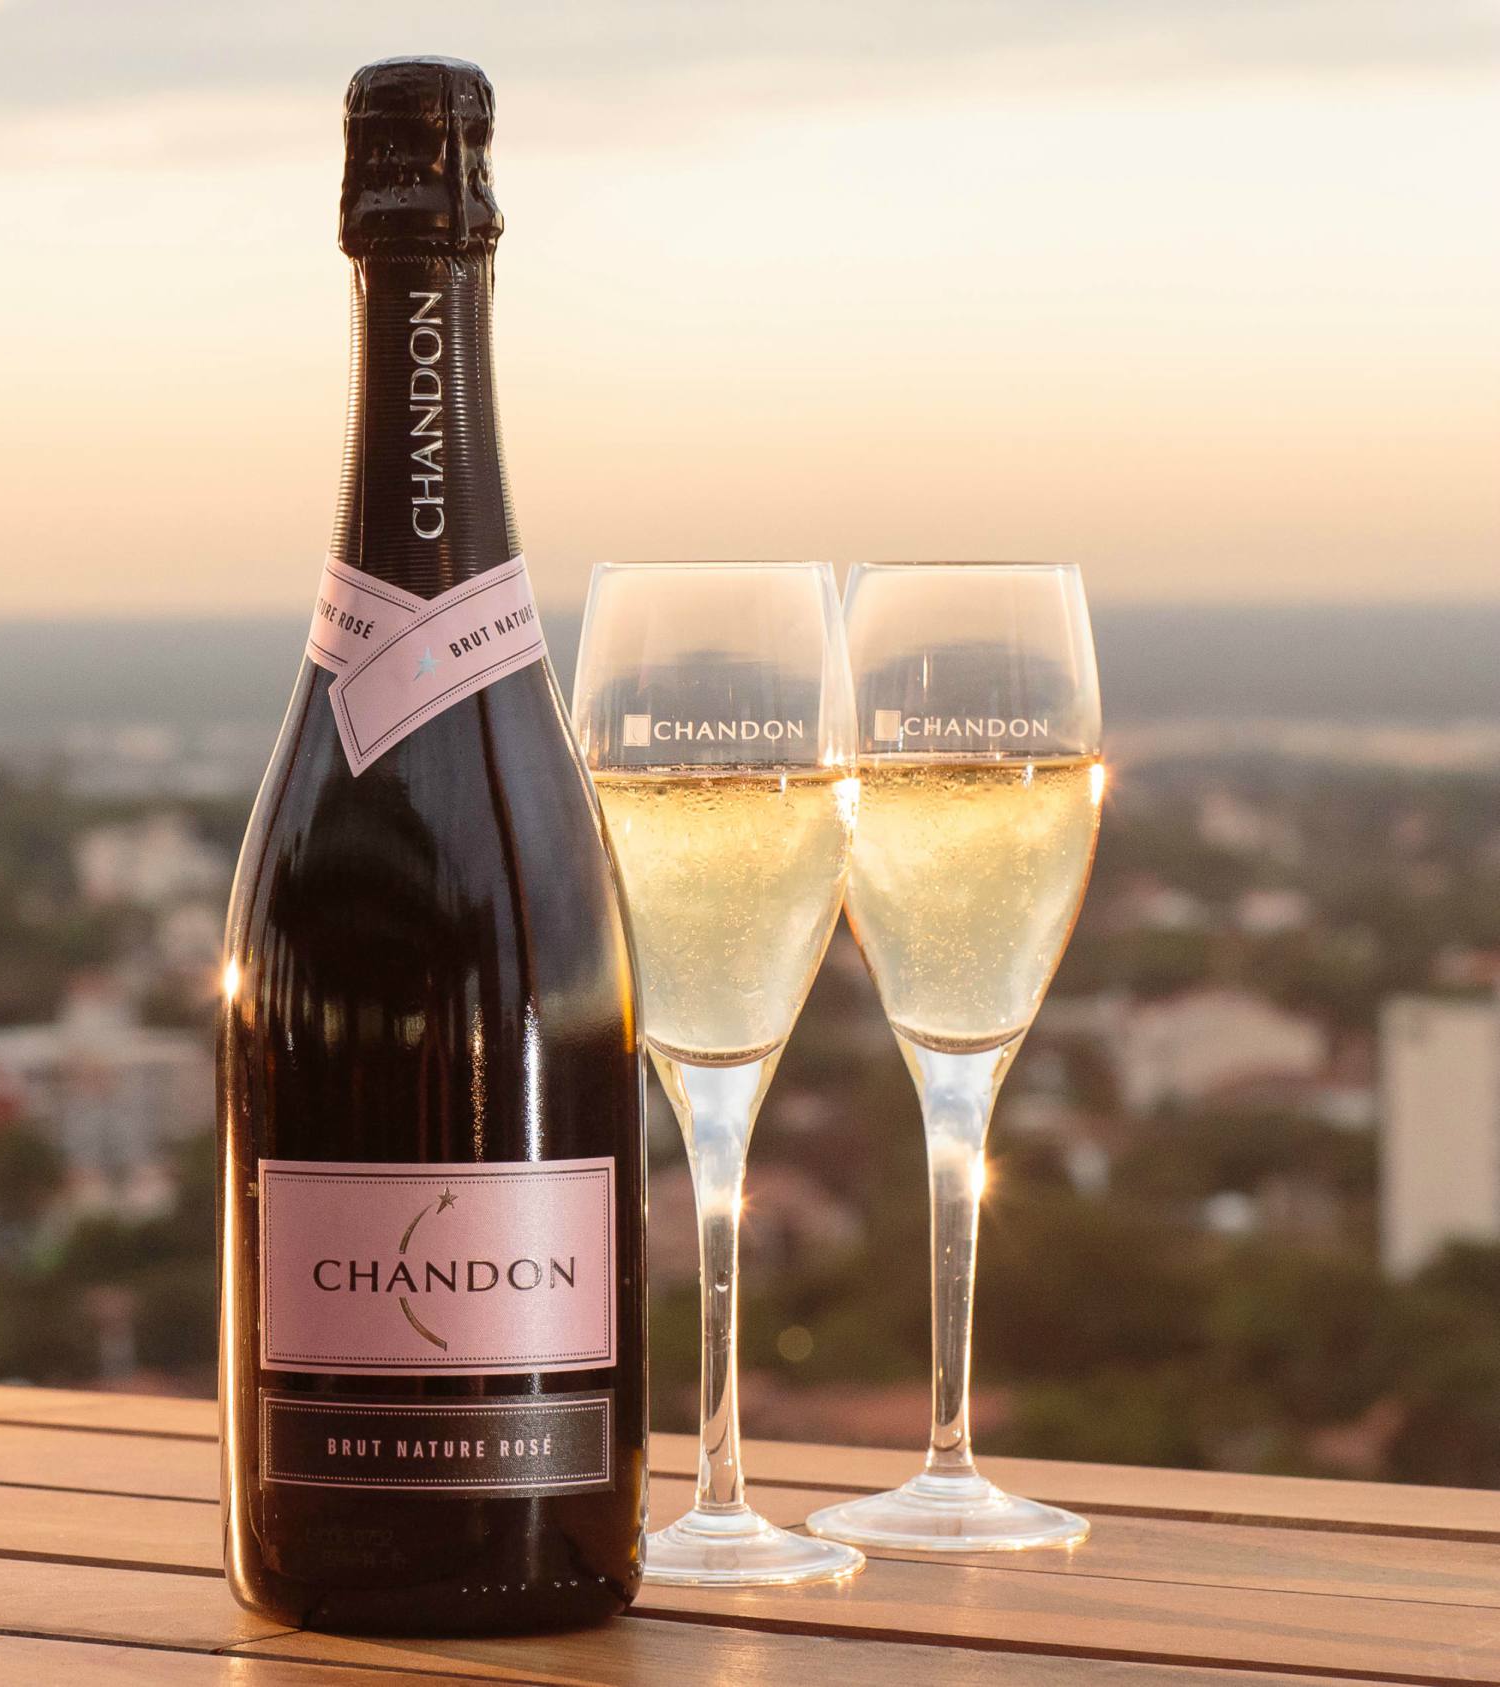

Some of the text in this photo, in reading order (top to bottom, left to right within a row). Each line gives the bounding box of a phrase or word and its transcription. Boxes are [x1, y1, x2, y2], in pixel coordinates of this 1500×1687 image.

[409, 291, 445, 540] CHANDON
[337, 611, 376, 640] ROSÉ
[448, 603, 534, 658] BRUT NATURE
[653, 719, 804, 741] CHANDON
[903, 715, 1049, 739] CHANDON
[312, 1256, 576, 1293] CHANDON
[327, 1432, 553, 1459] BRUT NATURE ROSÉ
